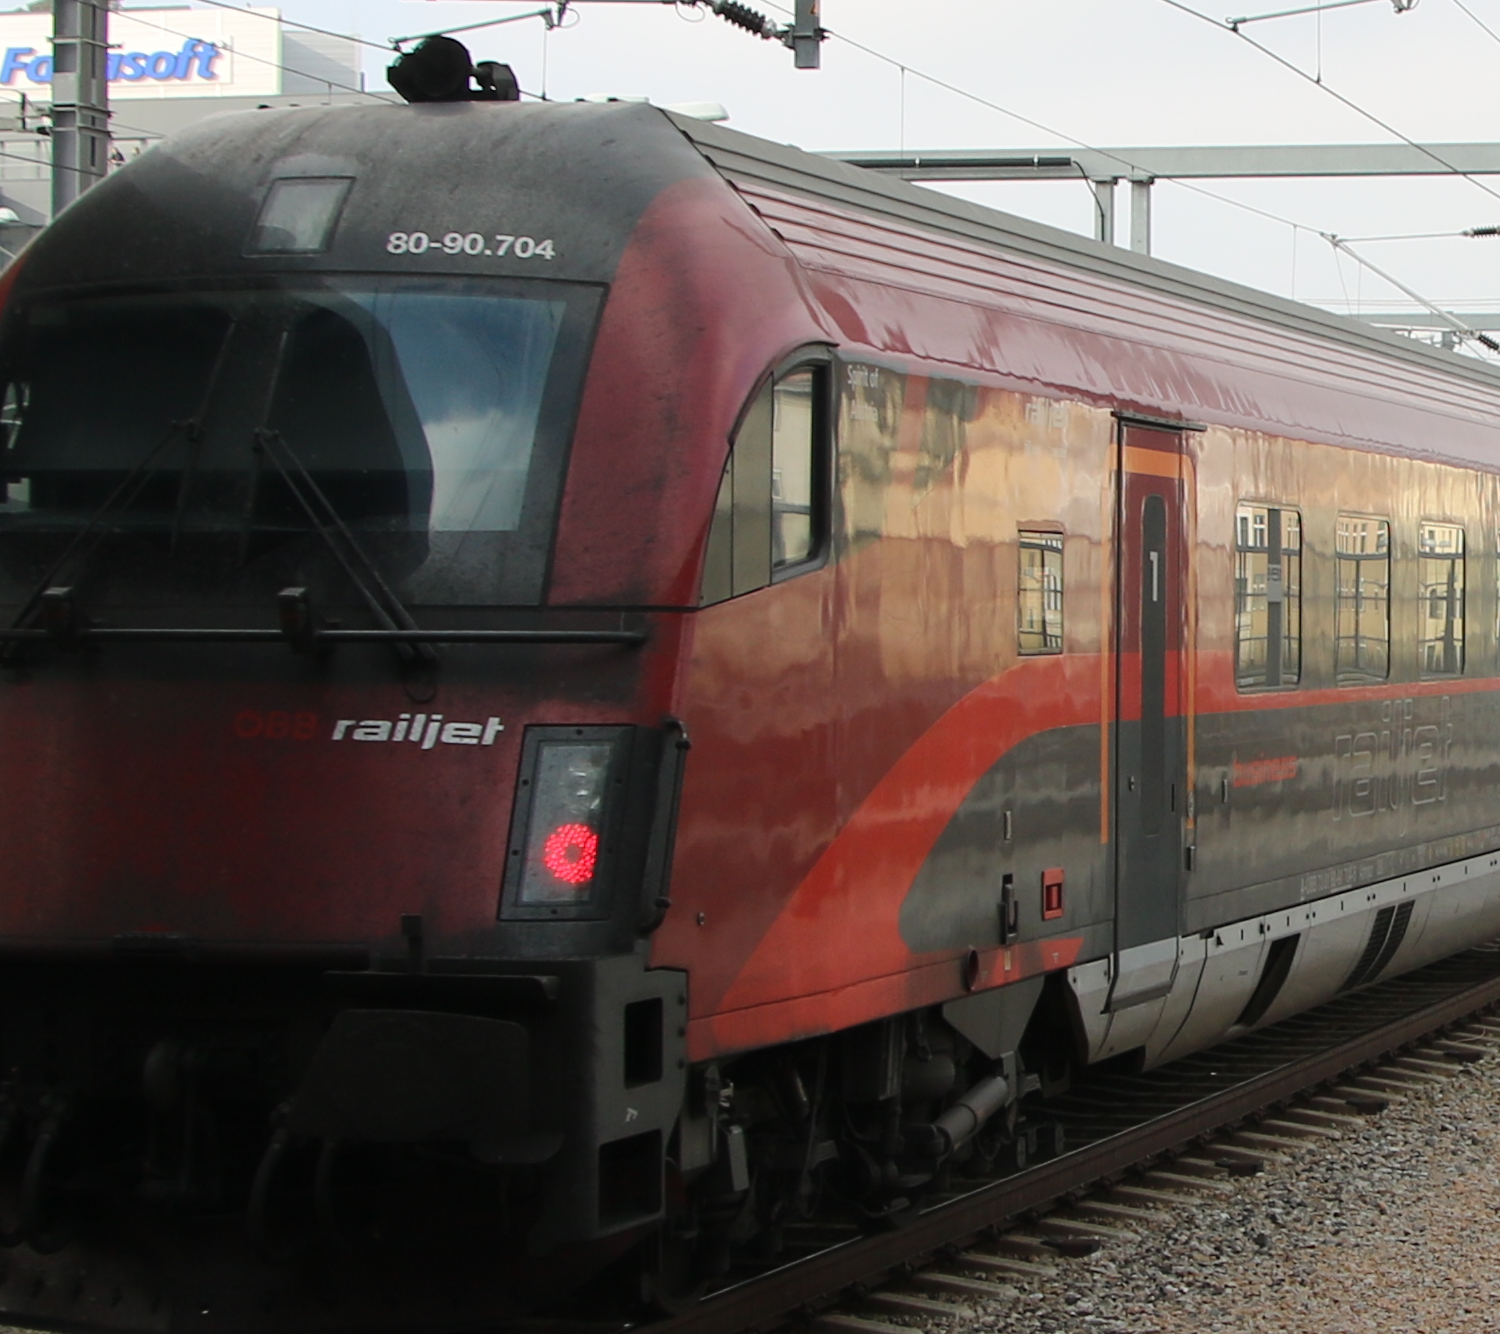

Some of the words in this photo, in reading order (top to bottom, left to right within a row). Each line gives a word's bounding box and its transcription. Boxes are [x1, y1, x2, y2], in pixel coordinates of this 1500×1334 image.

[386, 232, 557, 259] 80-90.704
[1150, 551, 1159, 602] 1
[331, 713, 505, 750] railjet
